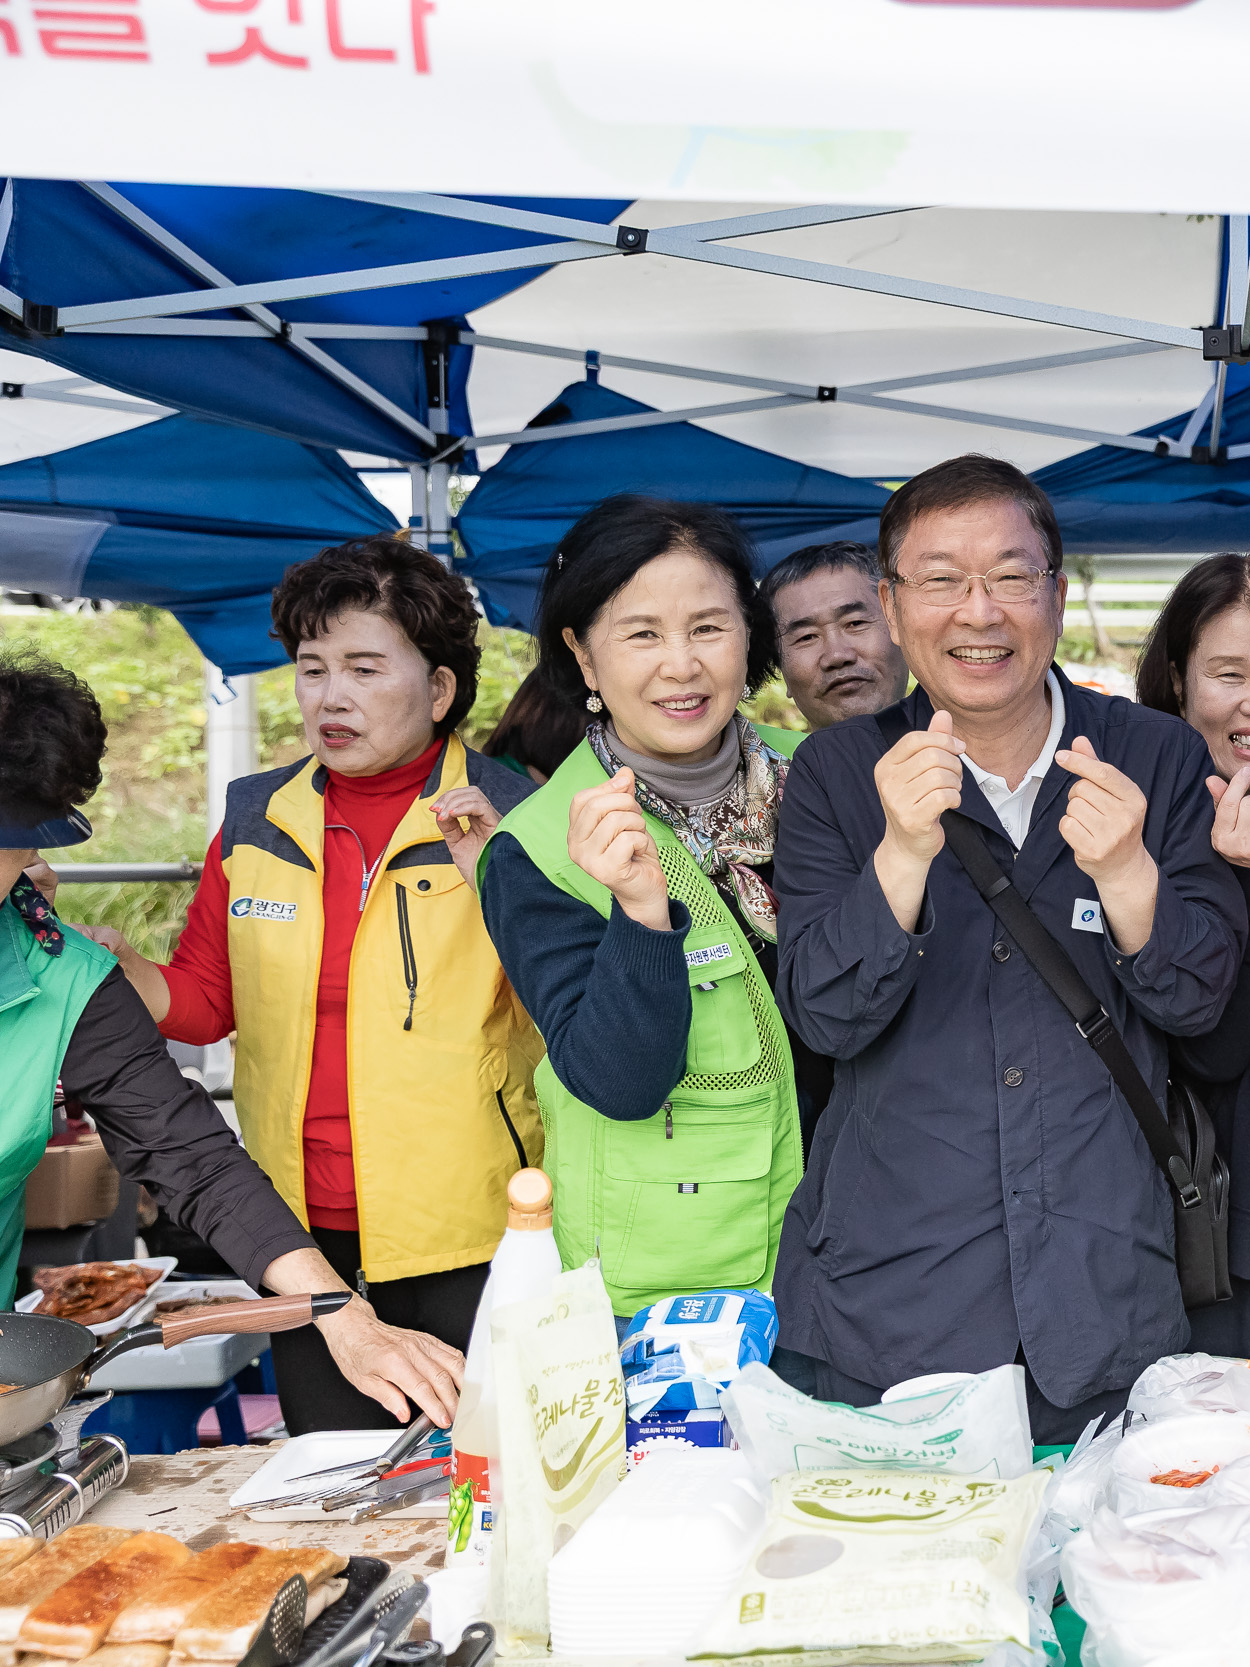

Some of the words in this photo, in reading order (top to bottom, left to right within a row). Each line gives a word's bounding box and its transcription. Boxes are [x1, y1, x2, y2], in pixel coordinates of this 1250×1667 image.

[254, 899, 297, 914] 광진구
[535, 1378, 601, 1443] 드레나물
[791, 1484, 938, 1508] 곤드레나물
